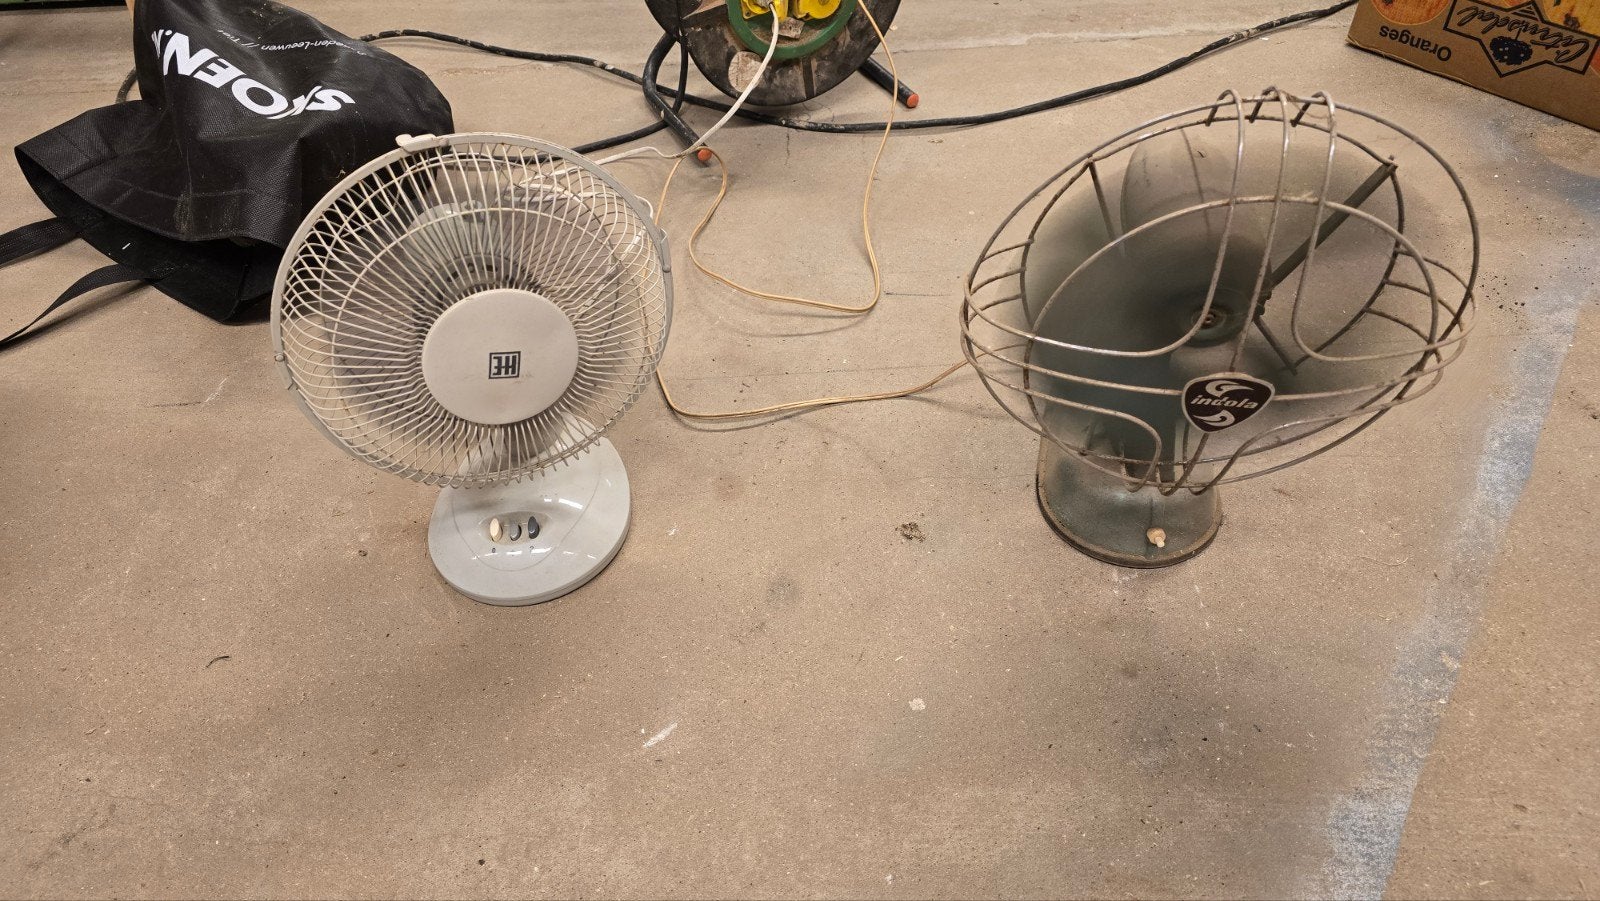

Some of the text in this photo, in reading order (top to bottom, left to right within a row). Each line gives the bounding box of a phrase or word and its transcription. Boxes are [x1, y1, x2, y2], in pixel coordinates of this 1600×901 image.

[1379, 25, 1452, 62] Oranges
[1456, 5, 1590, 64] Citrusdal
[1190, 395, 1259, 409] indola
